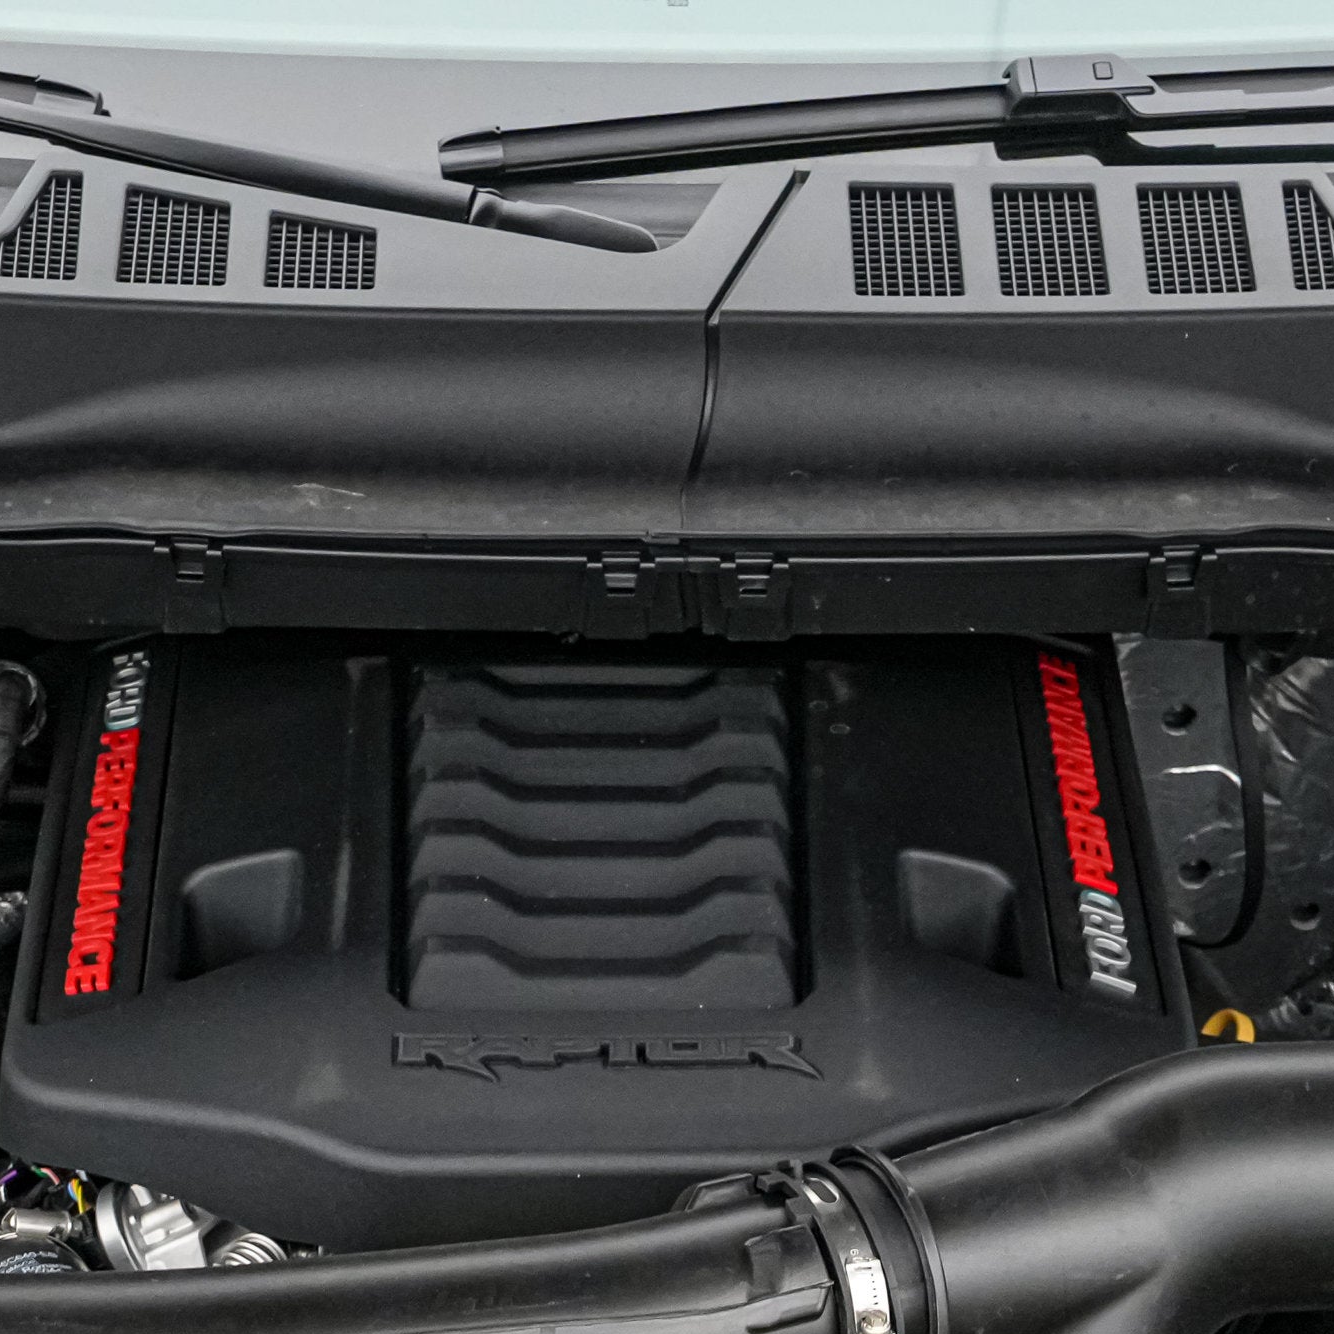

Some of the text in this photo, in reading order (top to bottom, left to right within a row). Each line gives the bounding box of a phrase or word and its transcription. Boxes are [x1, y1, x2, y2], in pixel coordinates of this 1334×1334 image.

[63, 650, 151, 998] FORD PERFORMANCE
[1037, 650, 1139, 995] FORD PERFORMANCE
[389, 1030, 823, 1084] RAPTOR
